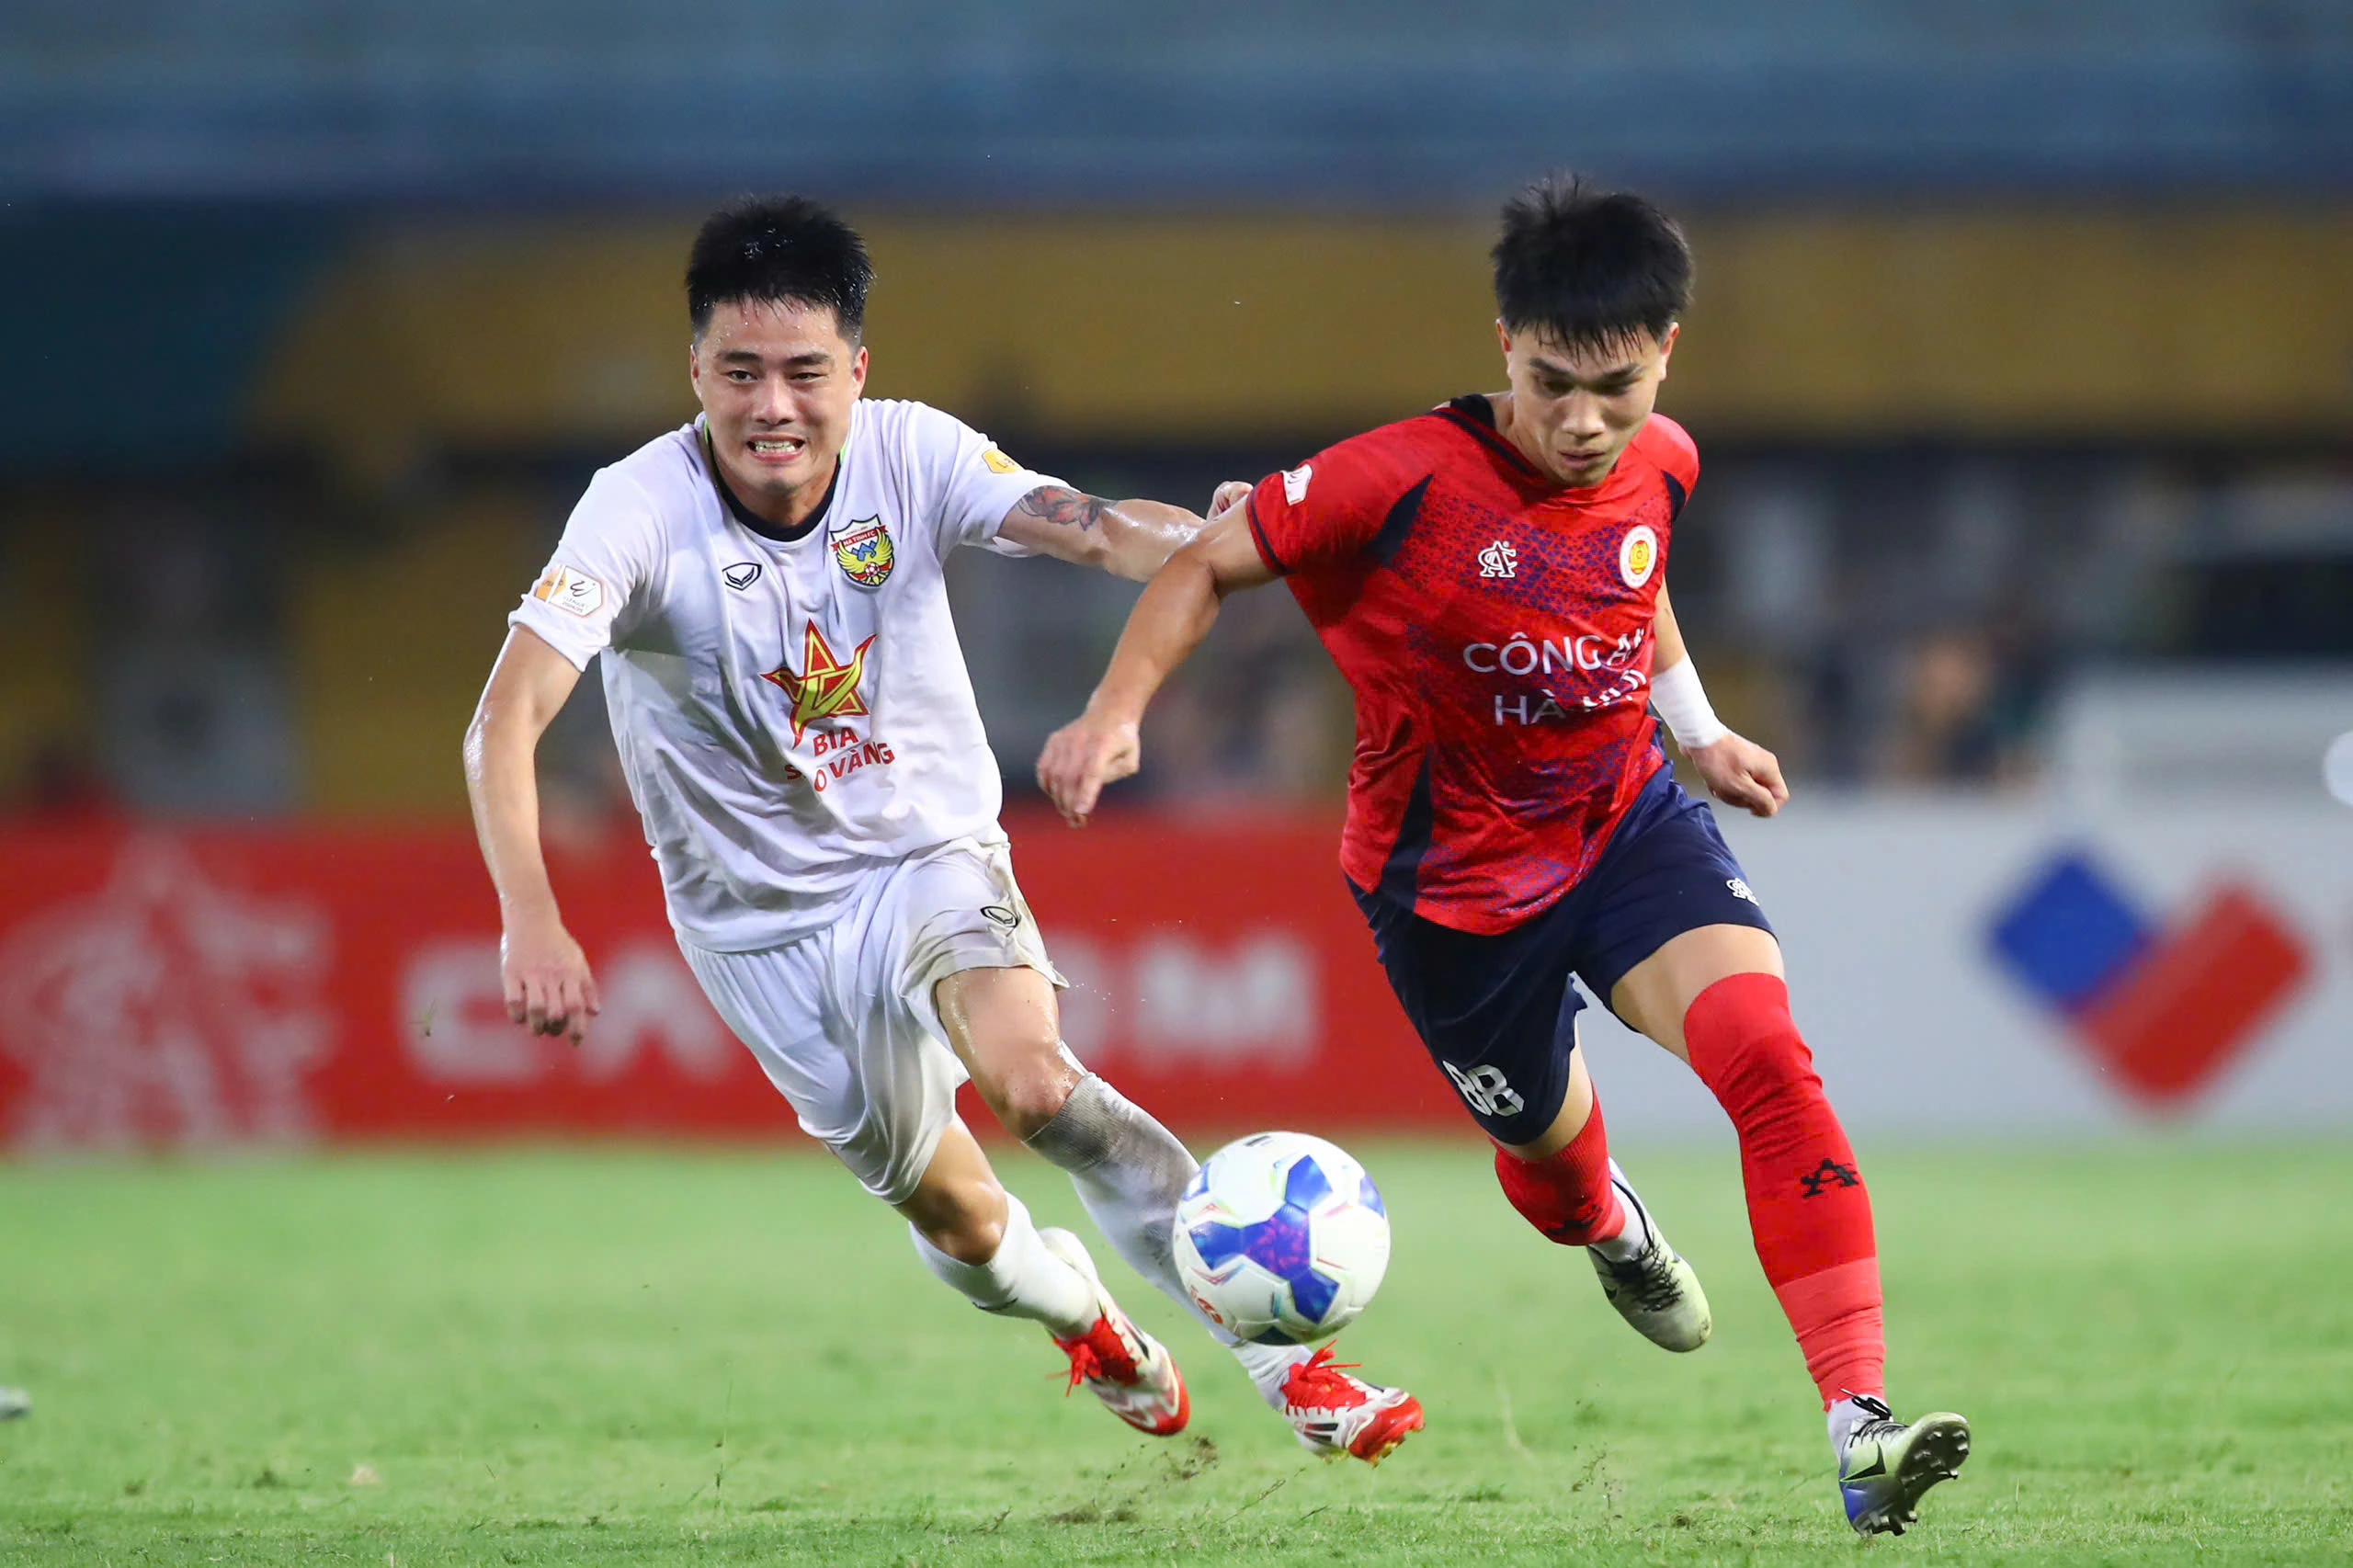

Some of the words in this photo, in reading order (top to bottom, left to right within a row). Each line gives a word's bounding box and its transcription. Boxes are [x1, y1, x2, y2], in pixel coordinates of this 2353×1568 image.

[1463, 631, 1603, 676] CÔNG
[1495, 688, 1566, 726] HÀ
[813, 727, 859, 756] BIA
[784, 764, 827, 792] SO
[828, 742, 895, 778] VÀNG
